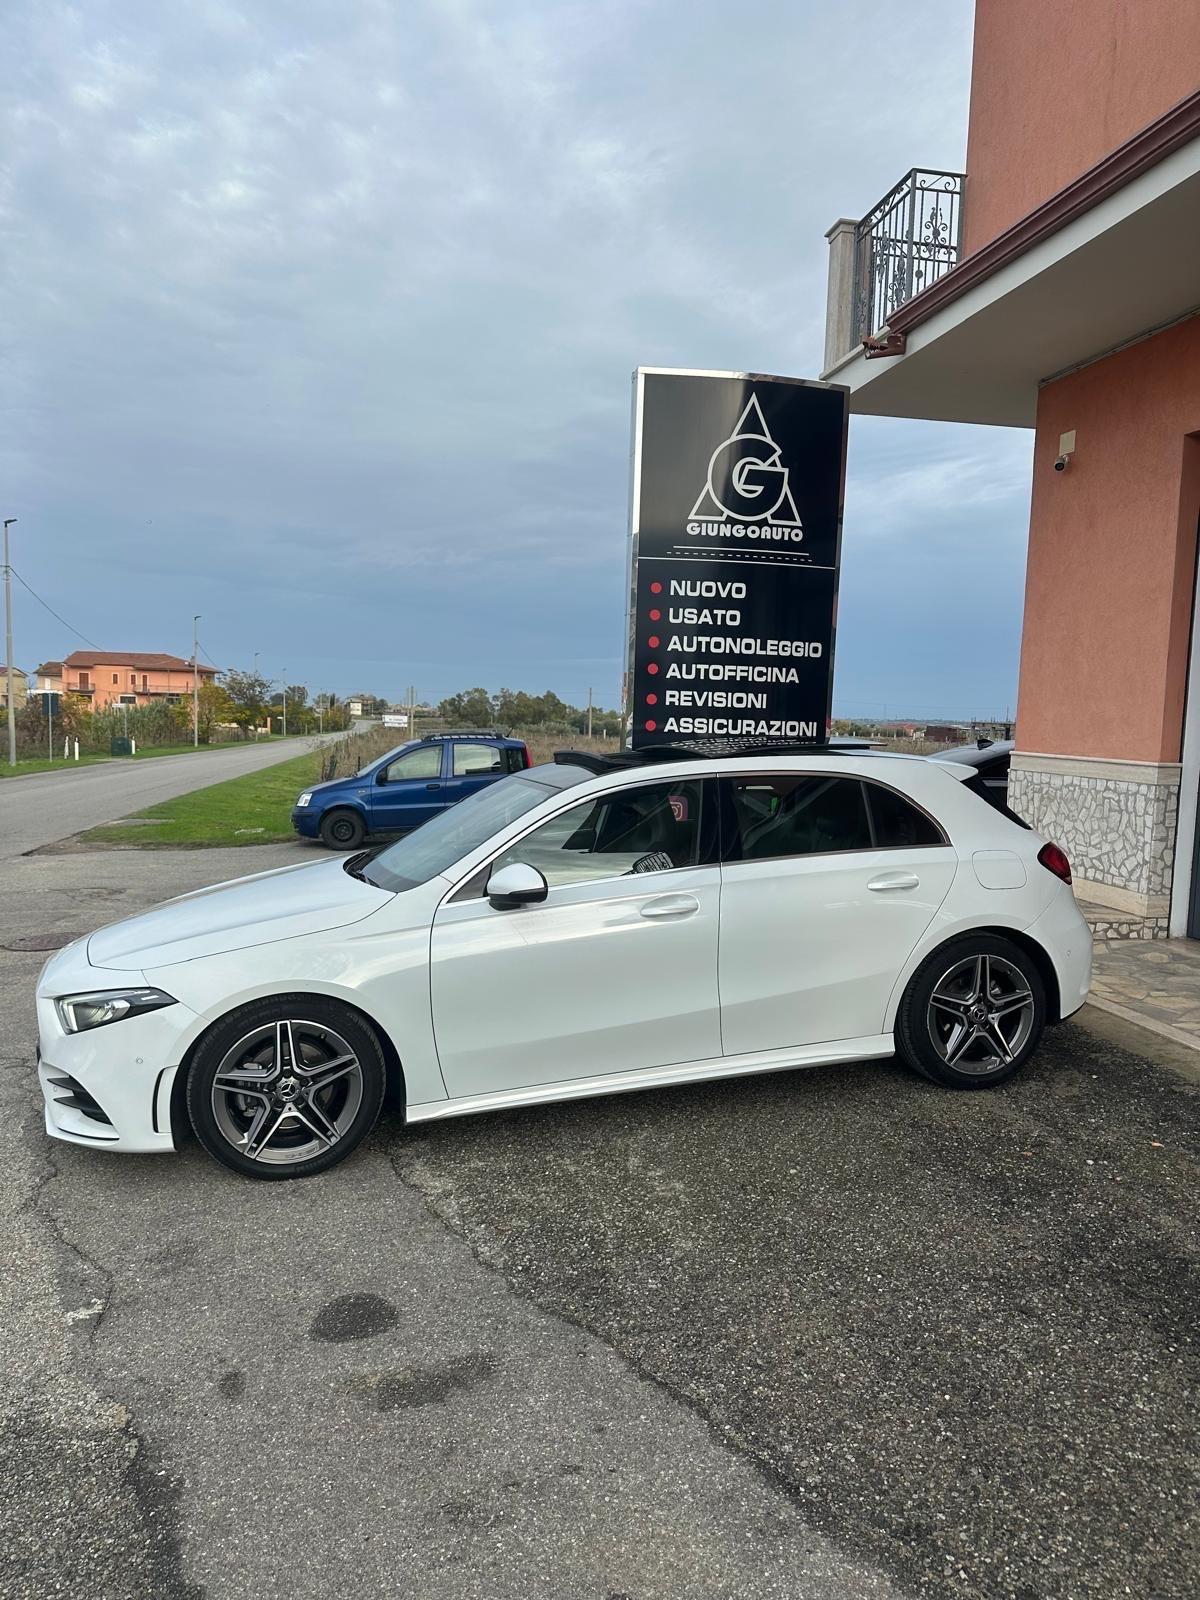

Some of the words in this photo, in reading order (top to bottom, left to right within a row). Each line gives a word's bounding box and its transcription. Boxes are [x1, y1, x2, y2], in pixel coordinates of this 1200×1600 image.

[686, 521, 803, 541] GIUNGOAUTO
[669, 579, 747, 599] NUOVO
[668, 607, 741, 626] USATO
[666, 635, 823, 658] AUTONOLEGGIO
[665, 663, 800, 684] AUTOFFICINA
[665, 689, 767, 709] REVISIONI
[663, 717, 817, 737] ASSICURAZIONI
